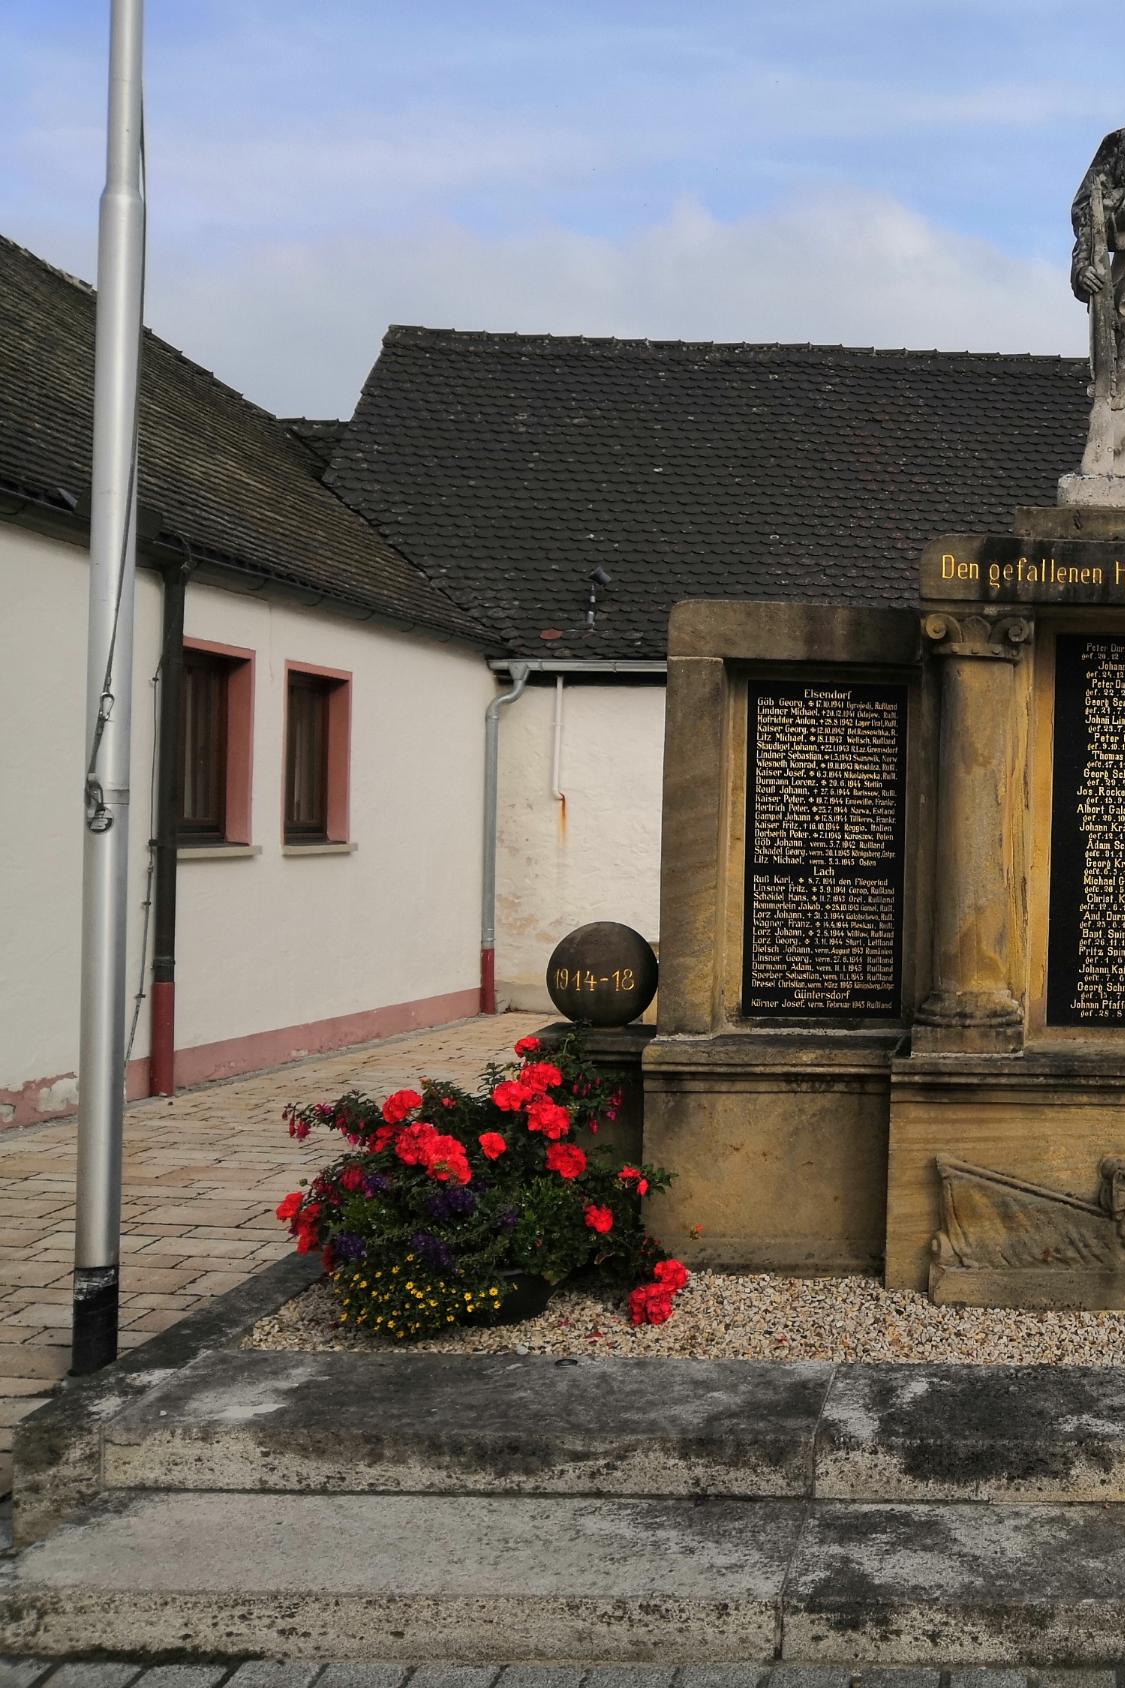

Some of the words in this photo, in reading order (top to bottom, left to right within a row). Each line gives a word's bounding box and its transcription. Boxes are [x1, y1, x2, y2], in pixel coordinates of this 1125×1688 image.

[941, 554, 980, 580] Den
[988, 557, 1103, 588] gefallenen
[1092, 680, 1114, 688] Peter
[804, 689, 852, 700] Elsendorf
[758, 706, 788, 715] Lindner
[791, 707, 819, 716] Michael.
[785, 725, 808, 734] Georg.
[775, 733, 806, 742] Michael.
[1094, 734, 1119, 742] Peter
[791, 742, 819, 751] Johann.
[757, 750, 785, 760] Lindner
[1092, 751, 1123, 760] Thomas
[790, 760, 818, 769] Konrad.
[756, 767, 782, 776] Kaiser
[784, 768, 806, 777] Josef.
[1084, 769, 1109, 779] Georg
[756, 776, 788, 786] Durmann
[791, 777, 818, 786] Lorenz.
[780, 786, 810, 794] Johann.
[756, 793, 781, 802] Kaiser
[784, 794, 805, 803] Peter.
[789, 803, 810, 812] Peter.
[1077, 804, 1104, 814] Albert
[755, 820, 779, 828] Kaiser
[783, 821, 801, 829] Fritz.
[1080, 823, 1108, 832] Johann
[790, 829, 811, 838] Peter.
[755, 837, 770, 846] Göb
[1087, 842, 1111, 850] Adam
[773, 855, 804, 864] Michael.
[859, 857, 876, 866] Osten
[1086, 860, 1111, 868] Georg
[814, 867, 834, 876] Lach
[754, 874, 769, 883] Ruß
[774, 875, 794, 884] Karl.
[1084, 876, 1116, 885] Michael
[753, 883, 785, 892] Linsner
[789, 884, 808, 892] Fritz.
[788, 892, 809, 901] Hans.
[798, 901, 823, 910] Jakob.
[753, 909, 771, 918] Lorz
[774, 910, 804, 919] Johann.
[753, 918, 783, 928] Wagner
[788, 919, 813, 927] Franz.
[753, 926, 771, 935] Lorz
[775, 927, 804, 936] Johann.
[753, 935, 771, 943] Lorz
[775, 936, 801, 945] Georg.
[783, 944, 813, 953] Johann.
[1079, 946, 1104, 956] Fritz
[786, 953, 812, 963] Georg.
[752, 961, 787, 970] Durmann
[1079, 965, 1109, 974] Johann
[752, 969, 783, 980] Sperber
[555, 968, 635, 992] 1914-18
[1077, 983, 1103, 992] Georg
[794, 991, 850, 999] Güntersdorf
